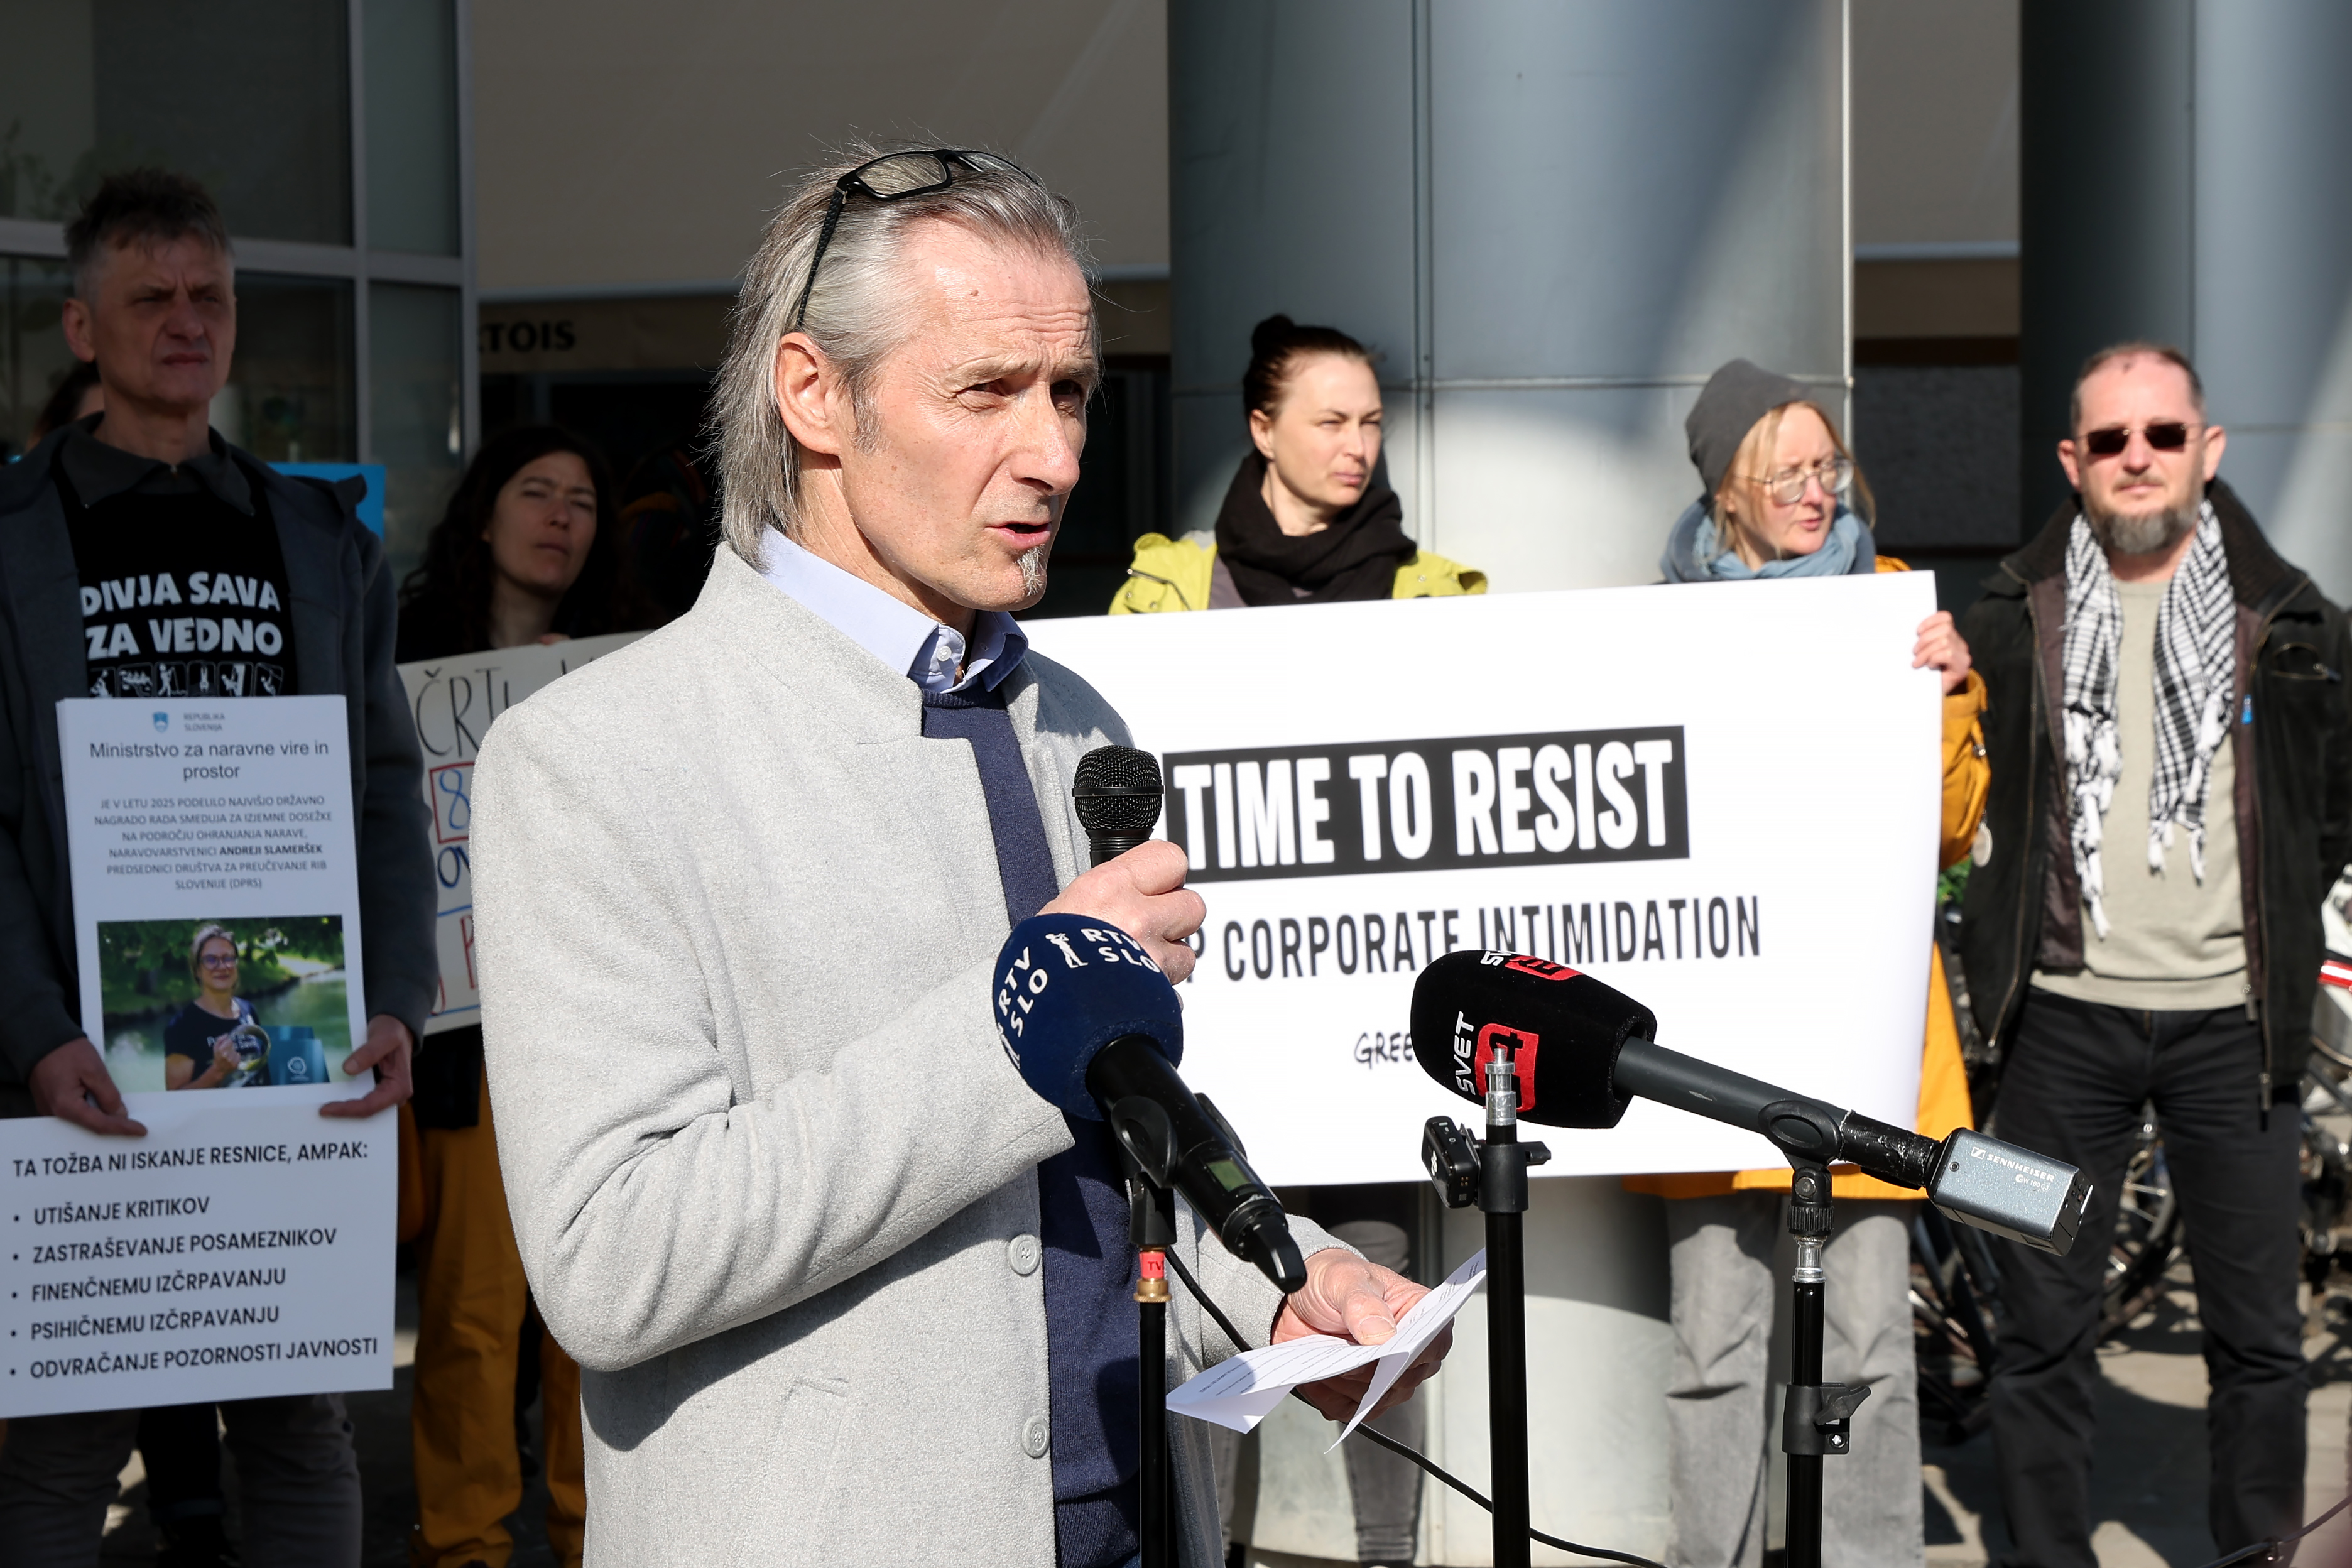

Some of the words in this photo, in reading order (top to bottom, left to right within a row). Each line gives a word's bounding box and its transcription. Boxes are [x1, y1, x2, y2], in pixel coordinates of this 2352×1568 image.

[480, 319, 576, 353] TOIS
[79, 572, 183, 617] DIVJA
[188, 570, 281, 612] SAVA
[85, 622, 141, 660] ZA
[148, 617, 283, 656] VEDNO
[183, 712, 225, 721] REPUBLIKA
[185, 722, 223, 732] SLOVENIJA
[90, 742, 180, 758] Ministrstvo
[184, 744, 203, 757] za
[209, 743, 275, 757] naravne
[280, 739, 309, 755] vire
[314, 739, 329, 755] in
[183, 763, 241, 783] prostor
[101, 798, 110, 809] JE
[112, 798, 121, 809] V
[122, 798, 148, 809] LETU
[151, 797, 175, 808] 2025
[177, 797, 226, 808] PODELILO
[276, 793, 325, 806] DRŽAVNO
[1173, 757, 1336, 871] TIME
[1349, 751, 1432, 861] TO
[1451, 739, 1673, 857] RESIST
[94, 815, 146, 825] NAGRADO
[148, 814, 177, 825] RADA
[229, 813, 242, 823] ZA
[288, 809, 332, 822] DOSEŽKE
[122, 831, 137, 841] NA
[139, 828, 193, 841] PODROČJU
[196, 829, 262, 840] OHRANJANJA
[109, 846, 217, 858] NARAVOVARSTVENICI
[220, 845, 261, 856] ANDREJI
[264, 842, 323, 855] SLAMERŠEK
[107, 863, 172, 875] PREDSEDNICI
[175, 861, 222, 874] DRUŠTVA
[224, 862, 237, 872] ZA
[239, 859, 308, 872] PREUČEVANJE
[310, 859, 327, 871] RIB
[175, 878, 226, 890] SLOVENIJE
[1081, 928, 1142, 952] RTV
[1224, 908, 1460, 983] CORPORATE
[1479, 895, 1760, 963] INTIMIDATION
[1098, 946, 1162, 973] SLO
[998, 945, 1031, 1016] RTV
[1010, 968, 1048, 1037] SLO
[1454, 1011, 1475, 1096] SVET
[13, 1159, 37, 1178] TA
[42, 1152, 103, 1175] TOŽBA
[108, 1153, 126, 1171] NI
[131, 1147, 205, 1170] ISKANJE
[210, 1145, 291, 1165] RESNICE,
[297, 1141, 368, 1162] AMPAK:
[1986, 1153, 2055, 1183] SENNHEISER
[33, 1201, 121, 1226] UTIŠANJE
[126, 1196, 210, 1219] KRITIKOV
[33, 1236, 185, 1265] ZASTRAŠEVANJE
[190, 1228, 337, 1252] POSAMEZNIKOV
[32, 1275, 151, 1302] FINENČNEMU
[156, 1268, 286, 1293] IZČRPAVANJU
[31, 1314, 145, 1341] PSIHIČNEMU
[150, 1305, 280, 1331] IZČRPAVANJU
[30, 1351, 159, 1379] ODVRAČANJE
[164, 1343, 281, 1369] POZORNOSTI
[286, 1337, 378, 1359] JAVNOSTI
